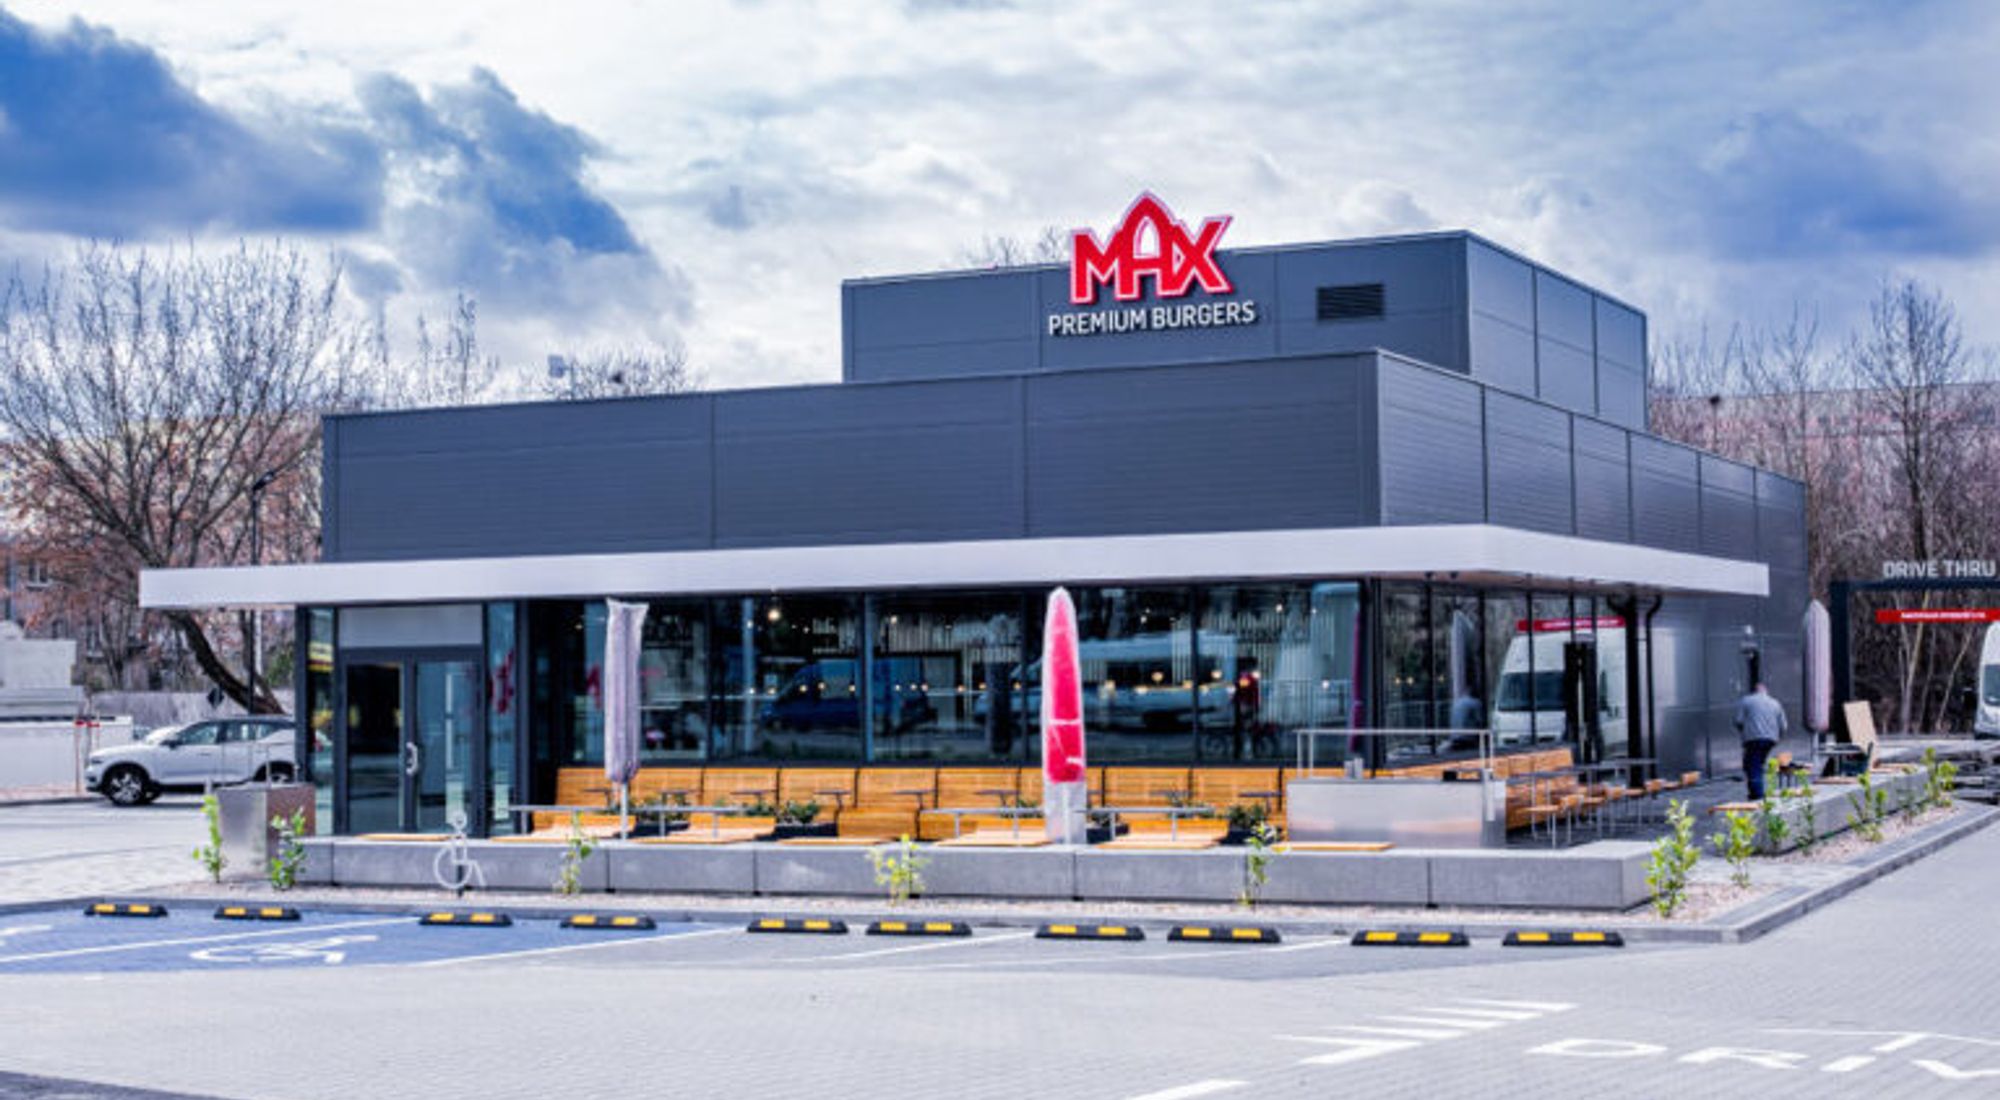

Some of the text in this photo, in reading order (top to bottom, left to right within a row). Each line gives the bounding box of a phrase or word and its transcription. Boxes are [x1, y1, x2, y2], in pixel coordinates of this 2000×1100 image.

[1069, 190, 1233, 304] MAX
[1049, 301, 1256, 336] PREMIUM BURGERS
[1883, 559, 1997, 578] DRIVE THRU
